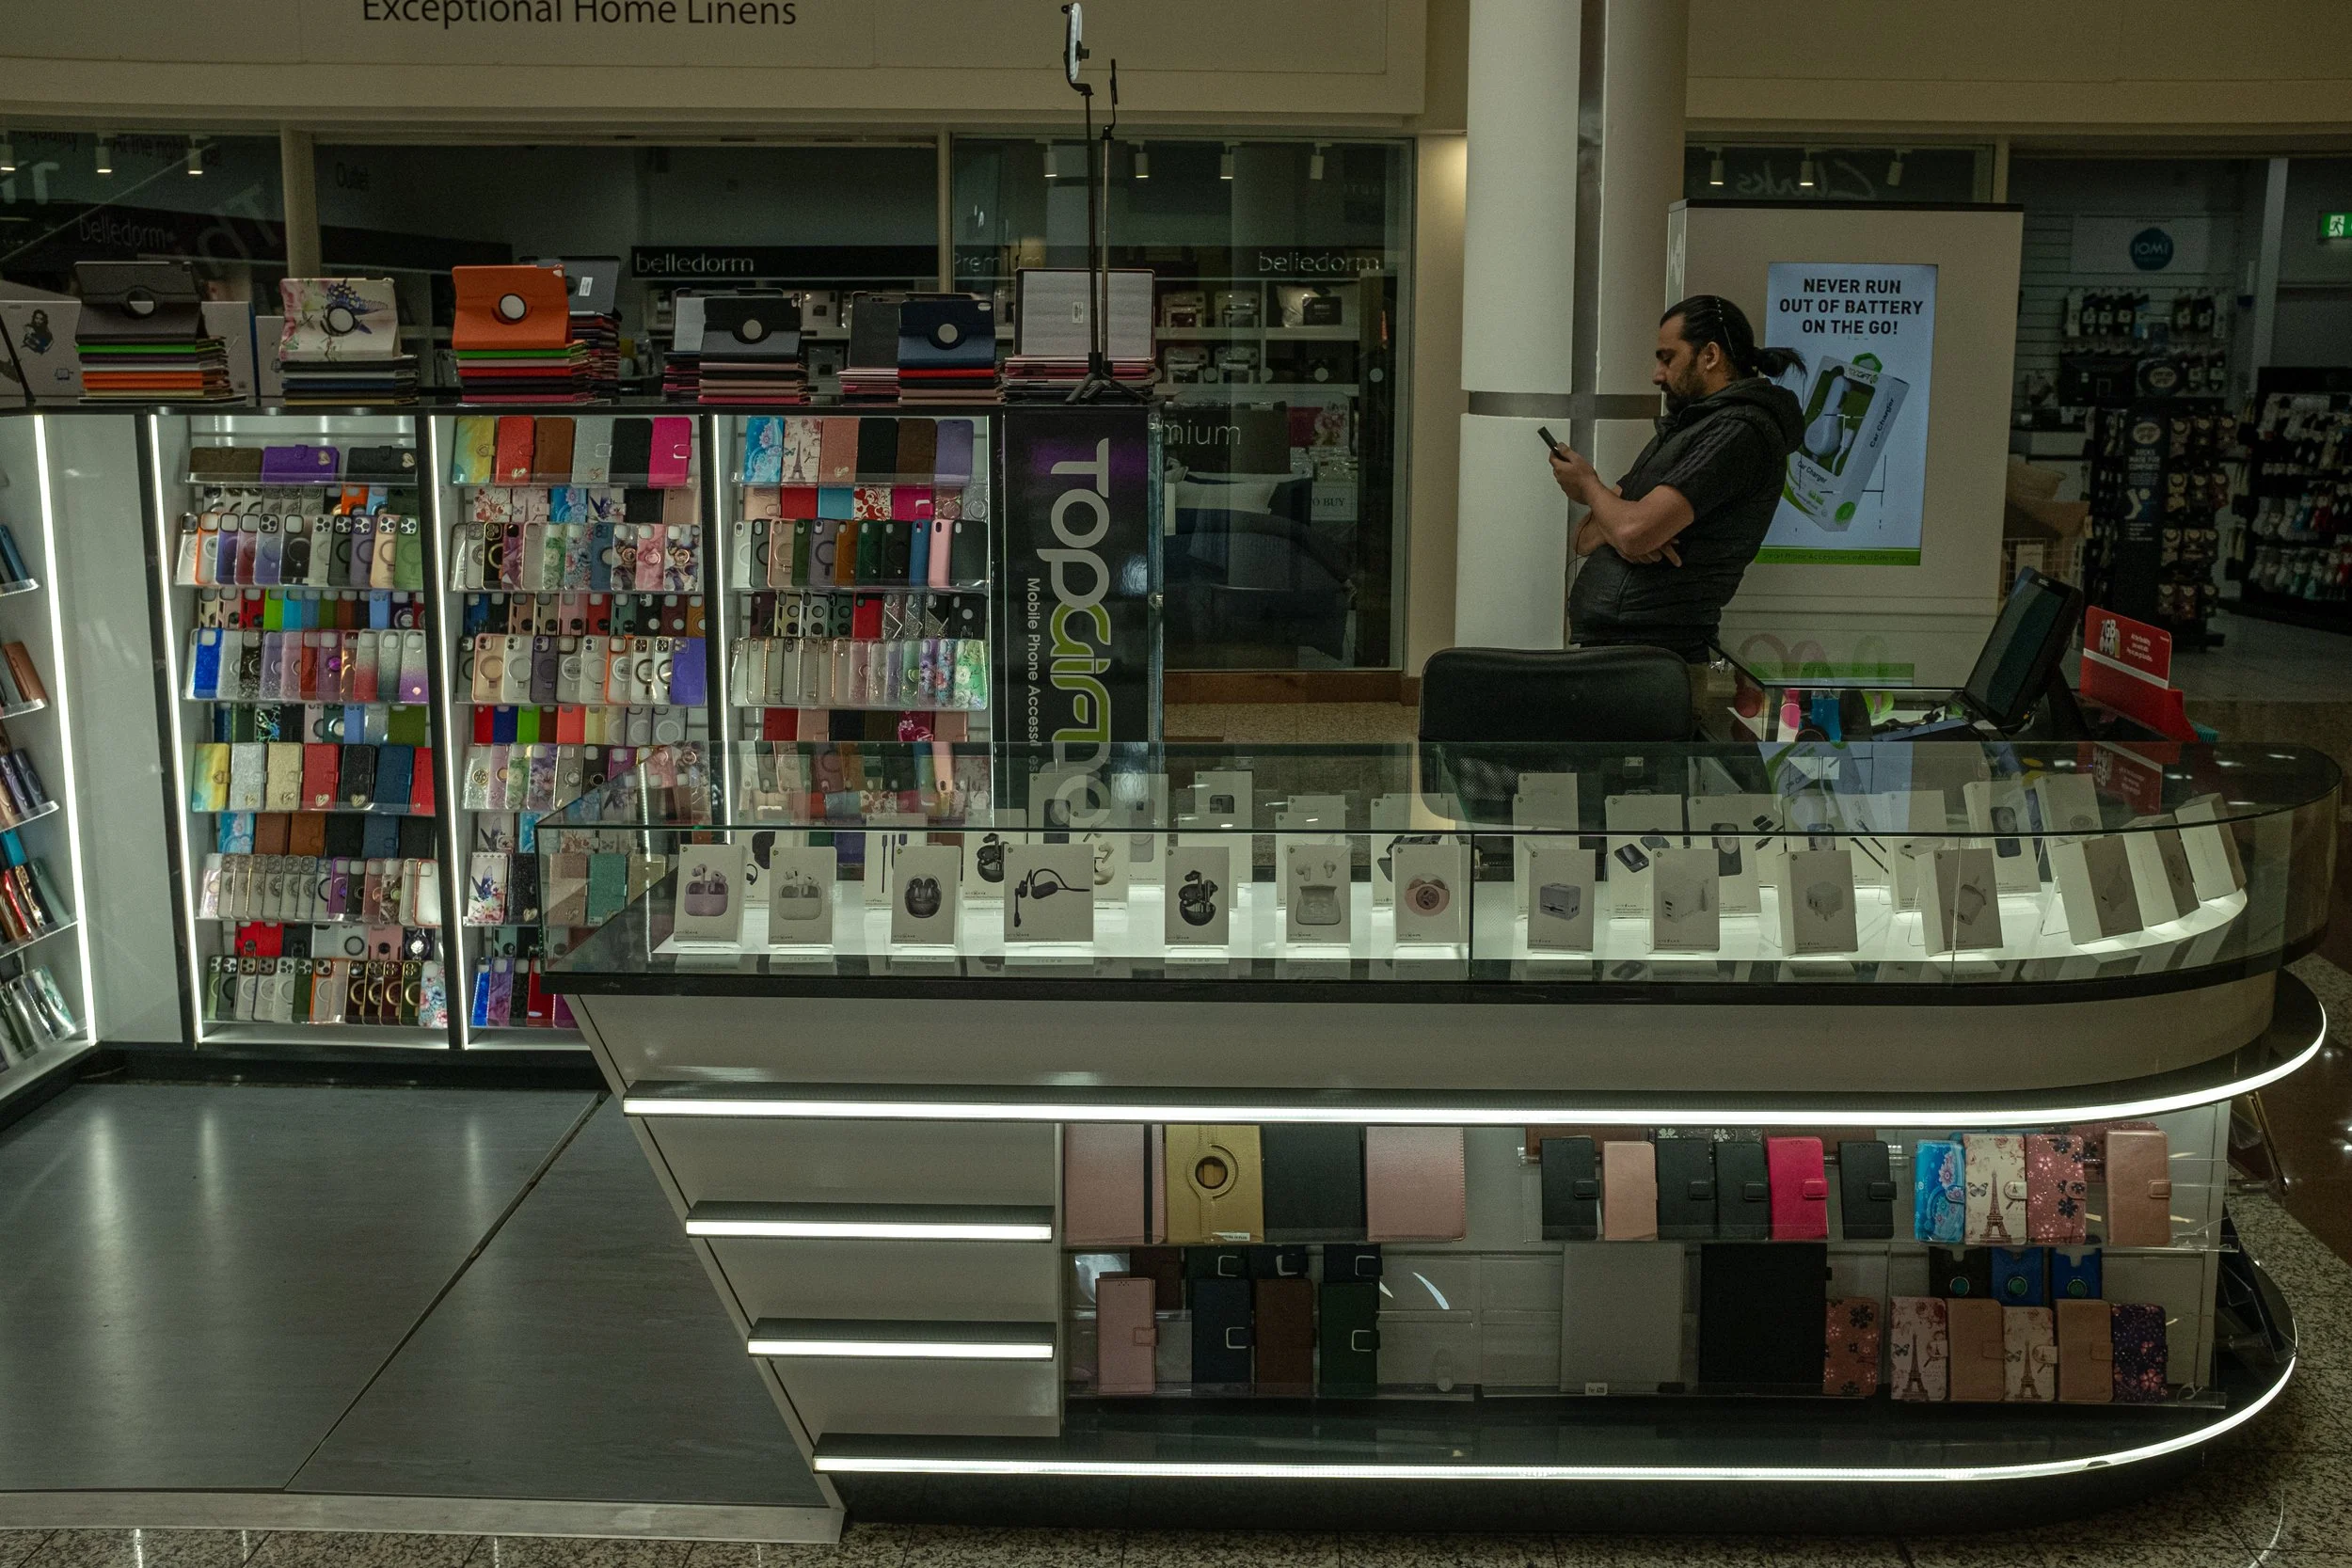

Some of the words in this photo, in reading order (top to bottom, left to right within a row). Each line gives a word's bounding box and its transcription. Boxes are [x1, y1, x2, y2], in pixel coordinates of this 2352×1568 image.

[363, 0, 563, 28] Exceptional
[575, 0, 676, 24] Home
[688, 0, 797, 25] Linens
[635, 252, 755, 273] belledorm
[1803, 278, 1860, 293] NEVER
[1865, 279, 1901, 294] RUN
[1780, 298, 1813, 313] OUT
[1818, 299, 1840, 313] OF
[1845, 300, 1924, 315] BATTERY
[1803, 319, 1825, 334] ON
[1831, 320, 1865, 335] THE
[1868, 321, 1899, 335] GO!
[1869, 432, 1880, 449] Car
[1877, 397, 1895, 432] Charger
[1323, 498, 1345, 507] BUY
[1026, 577, 1041, 630] Mobile
[1026, 633, 1041, 682] Phone
